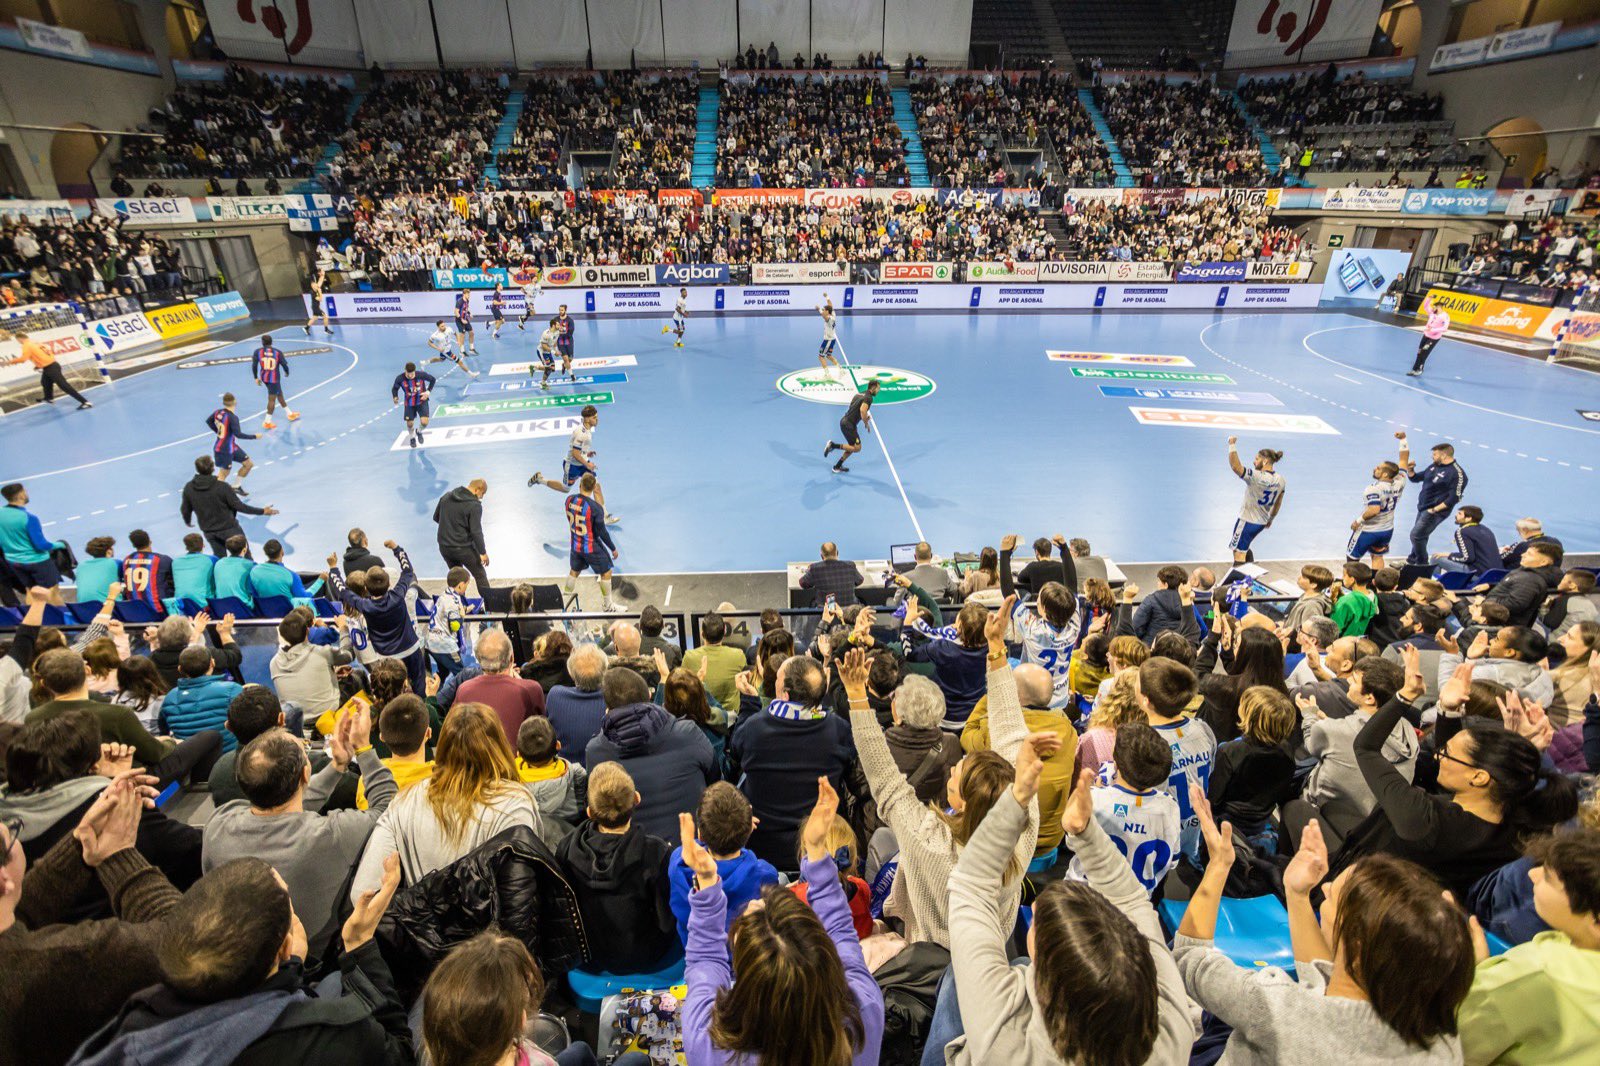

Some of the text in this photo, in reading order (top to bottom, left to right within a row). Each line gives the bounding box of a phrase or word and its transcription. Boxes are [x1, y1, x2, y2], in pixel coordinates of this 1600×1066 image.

[128, 199, 180, 214] staci
[767, 195, 799, 205] DAMM
[1431, 197, 1489, 206] TOP TOYS
[239, 204, 287, 215] ILCA
[457, 271, 505, 283] TOP TOYS
[550, 272, 571, 282] KH7
[600, 268, 650, 283] hummel
[662, 263, 723, 283] Agbar
[885, 266, 933, 278] SPAR
[1179, 265, 1244, 278] Sagalés
[212, 299, 244, 313] TOP TOYS
[1438, 296, 1480, 314] FRAIKIN
[106, 314, 148, 337] staci
[161, 308, 200, 327] FRAIKIN
[41, 338, 80, 355] PAR
[261, 357, 277, 371] 10
[1113, 370, 1226, 382] plenitude
[485, 394, 608, 412] plenitude
[1142, 410, 1282, 428] SPAR
[445, 417, 583, 439] FRAIKIN
[1258, 489, 1278, 507] 31
[567, 510, 588, 537] 25
[124, 566, 150, 592] 19
[1171, 751, 1211, 772] ARNAU
[1168, 761, 1212, 820] 11
[1123, 823, 1148, 834] NIL
